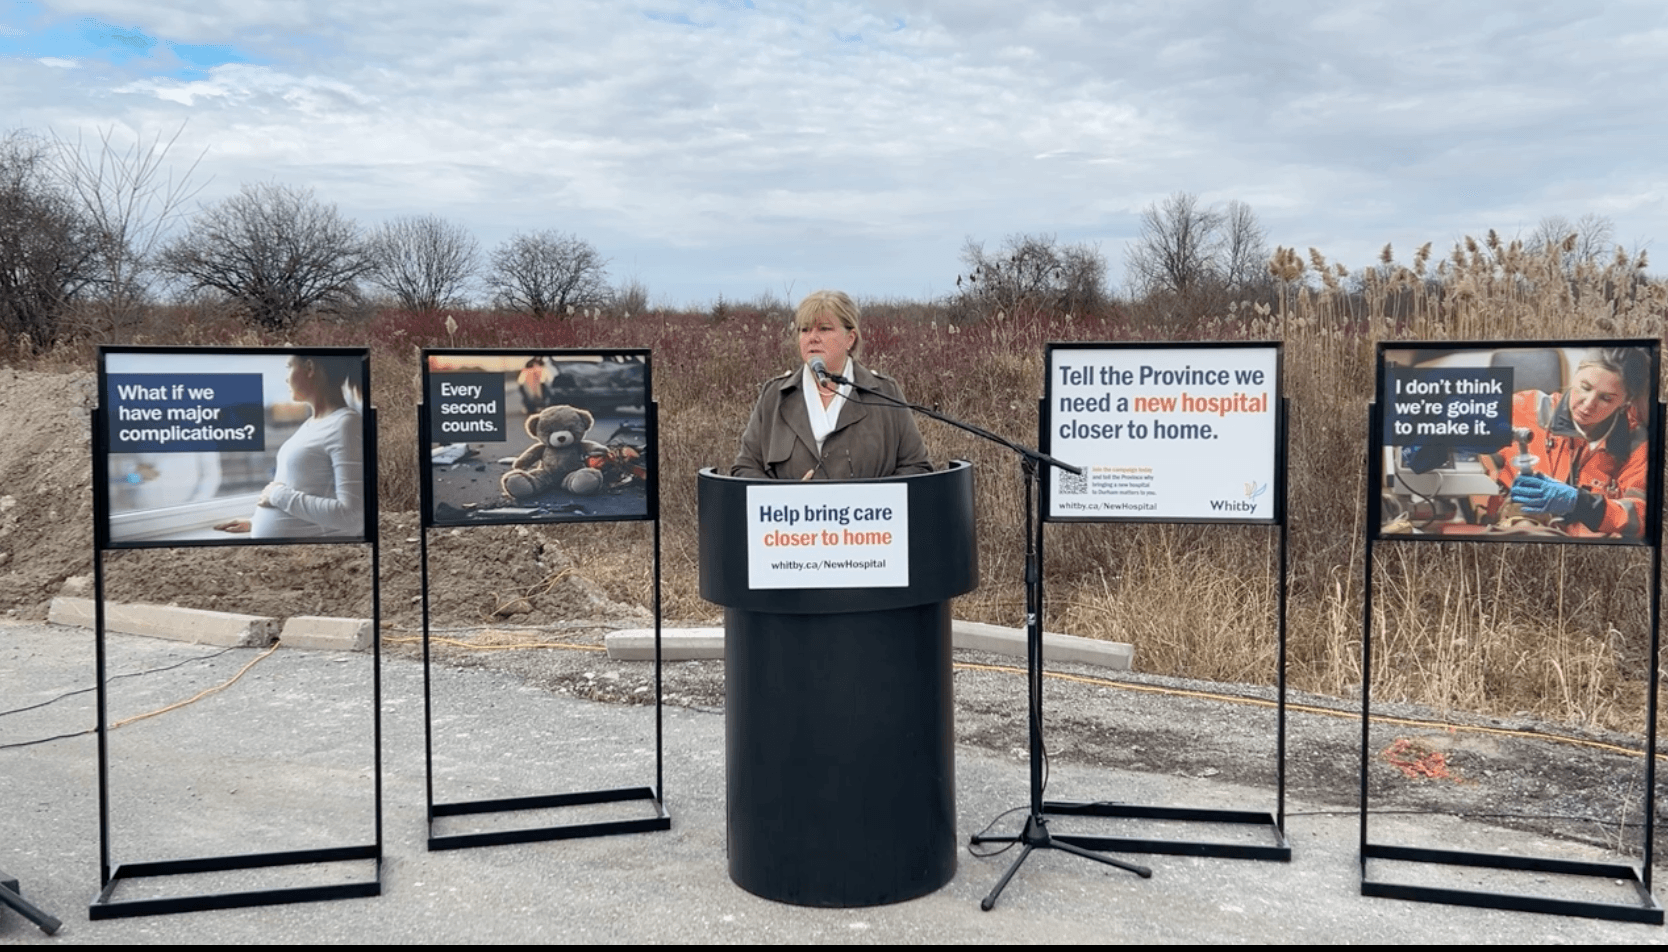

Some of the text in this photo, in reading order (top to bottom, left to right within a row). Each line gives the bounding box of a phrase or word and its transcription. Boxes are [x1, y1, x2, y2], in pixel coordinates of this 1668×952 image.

[1059, 365, 1265, 386] Tell the Province we
[117, 384, 215, 400] What if we
[441, 382, 482, 399] Every
[1396, 379, 1503, 394] I don’t think
[441, 400, 496, 414] second
[1060, 392, 1267, 417] need a new hospital
[1394, 399, 1499, 418] we’re going
[119, 405, 221, 424] have major
[119, 424, 256, 444] complications?
[441, 419, 498, 432] counts.
[1059, 419, 1218, 439] closer to home.
[1394, 420, 1491, 435] to make it.
[1059, 502, 1157, 511] whitby.ca/NewHospital
[1210, 500, 1257, 514] Whitby
[760, 505, 893, 526] Help bring care
[763, 528, 892, 546] closer to home
[771, 559, 886, 571] whitby.ca/NewHospital
